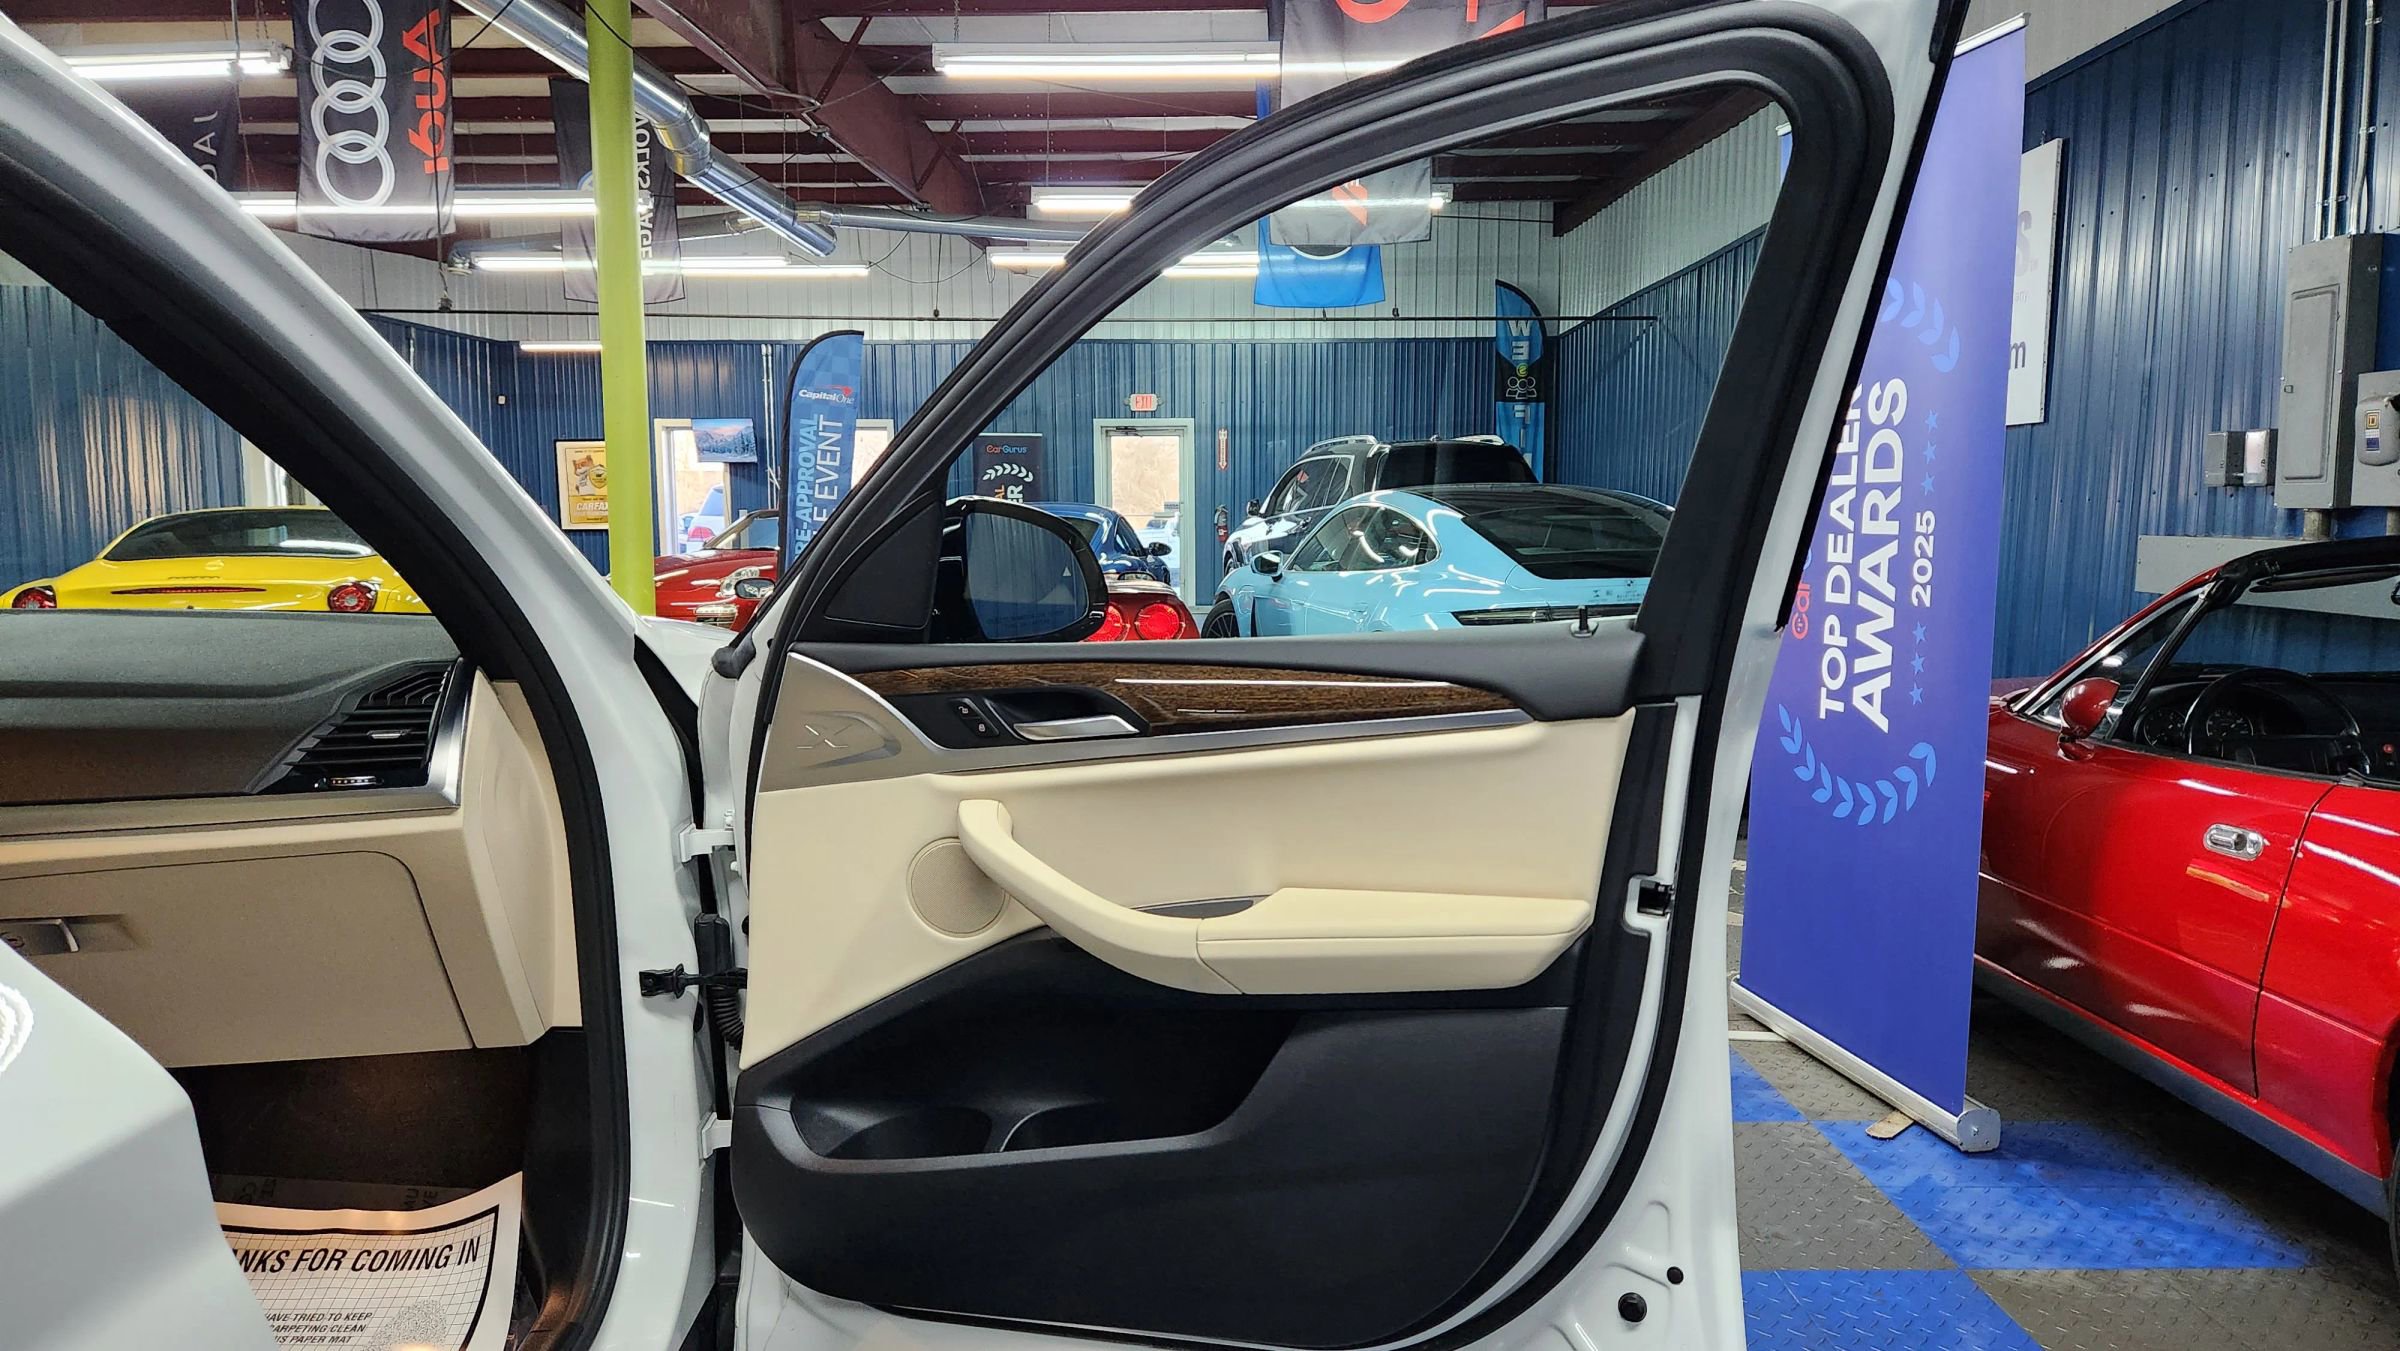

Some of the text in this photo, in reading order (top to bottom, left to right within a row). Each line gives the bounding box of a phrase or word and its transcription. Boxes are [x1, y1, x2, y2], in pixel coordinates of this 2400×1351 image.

[814, 414, 842, 500] EVENT
[986, 444, 1028, 454] CarGurus
[1852, 377, 1908, 734] AWARDS
[1911, 510, 1936, 608] 2025
[1819, 614, 1849, 719] TOP
[232, 1236, 481, 1273] NKS FOR COMING IN
[269, 1324, 366, 1333] ARPETING CLEAN
[292, 1312, 325, 1322] TRIED
[328, 1312, 342, 1322] TO
[344, 1312, 373, 1321] KEEP
[289, 1335, 325, 1343] PAPER
[328, 1335, 353, 1343] MAT
